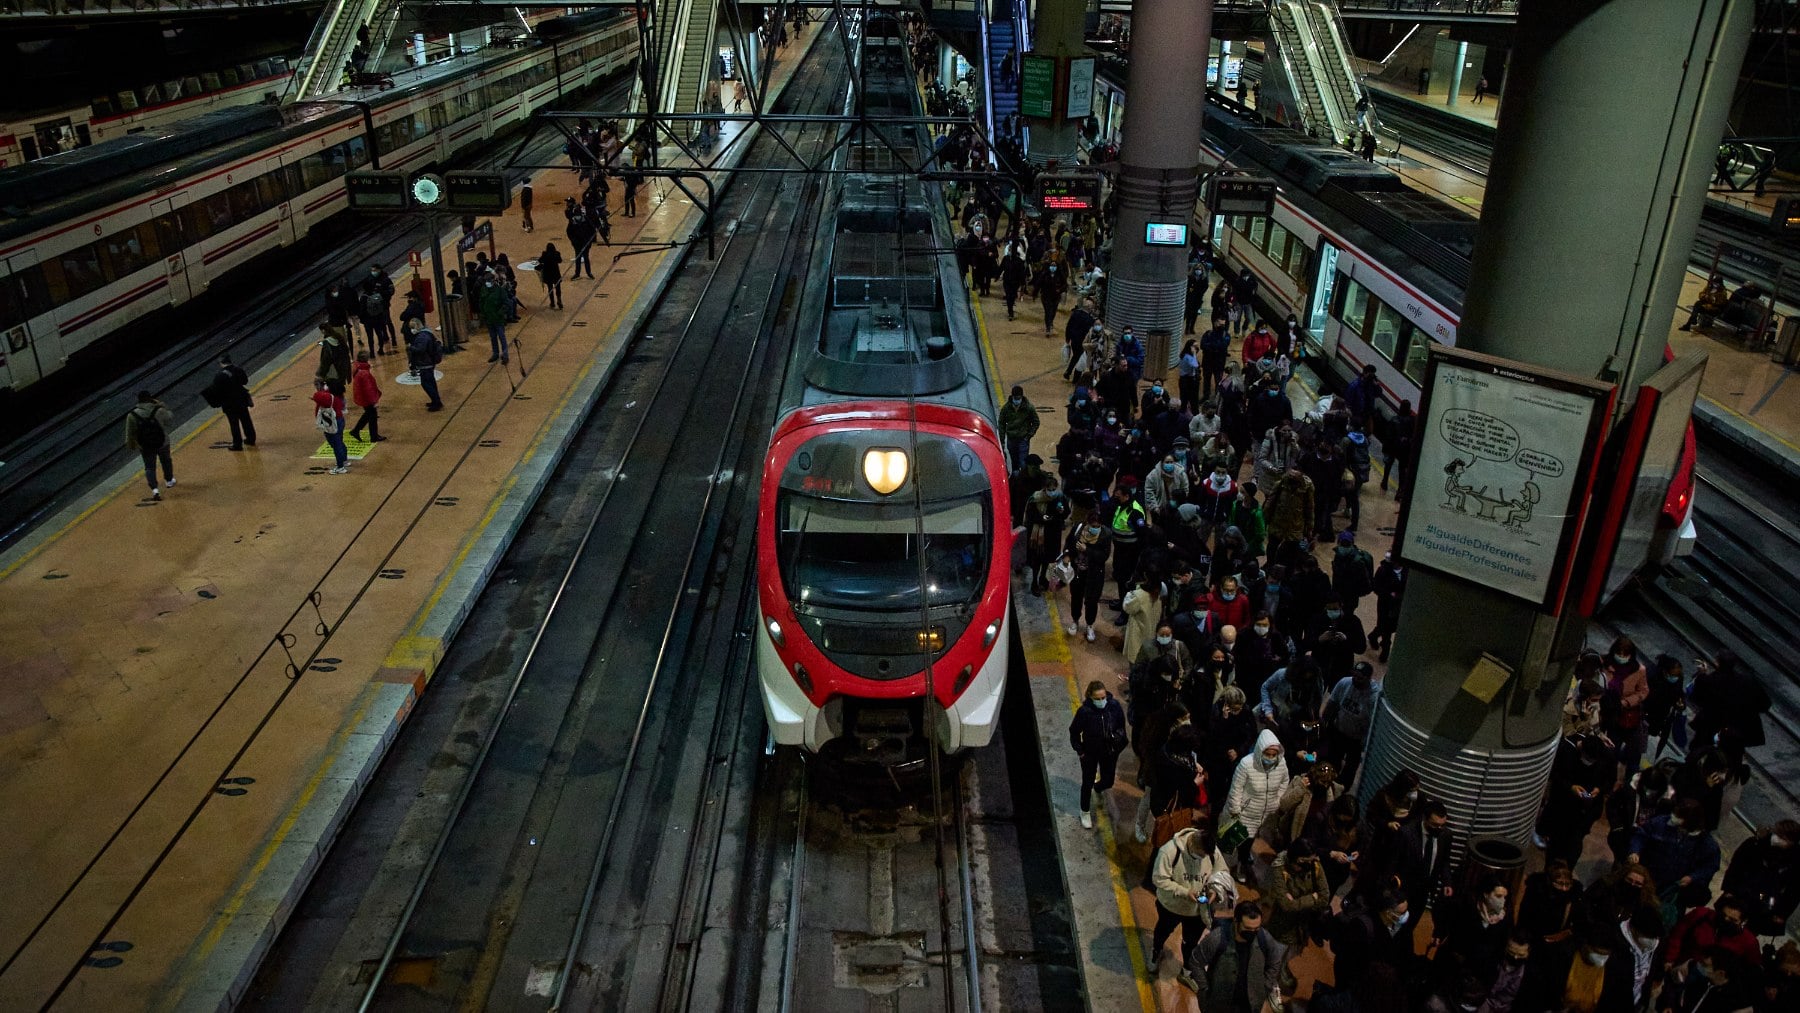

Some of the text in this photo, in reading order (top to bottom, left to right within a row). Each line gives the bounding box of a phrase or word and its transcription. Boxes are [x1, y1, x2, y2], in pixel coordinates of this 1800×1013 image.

[1406, 303, 1422, 318] renfe
[1499, 368, 1535, 383] exteriorplus
[1467, 419, 1485, 427] CHICA
[1426, 523, 1532, 565] #IgualdeDiferentes
[1415, 534, 1537, 582] #IgualdeProfesionales
